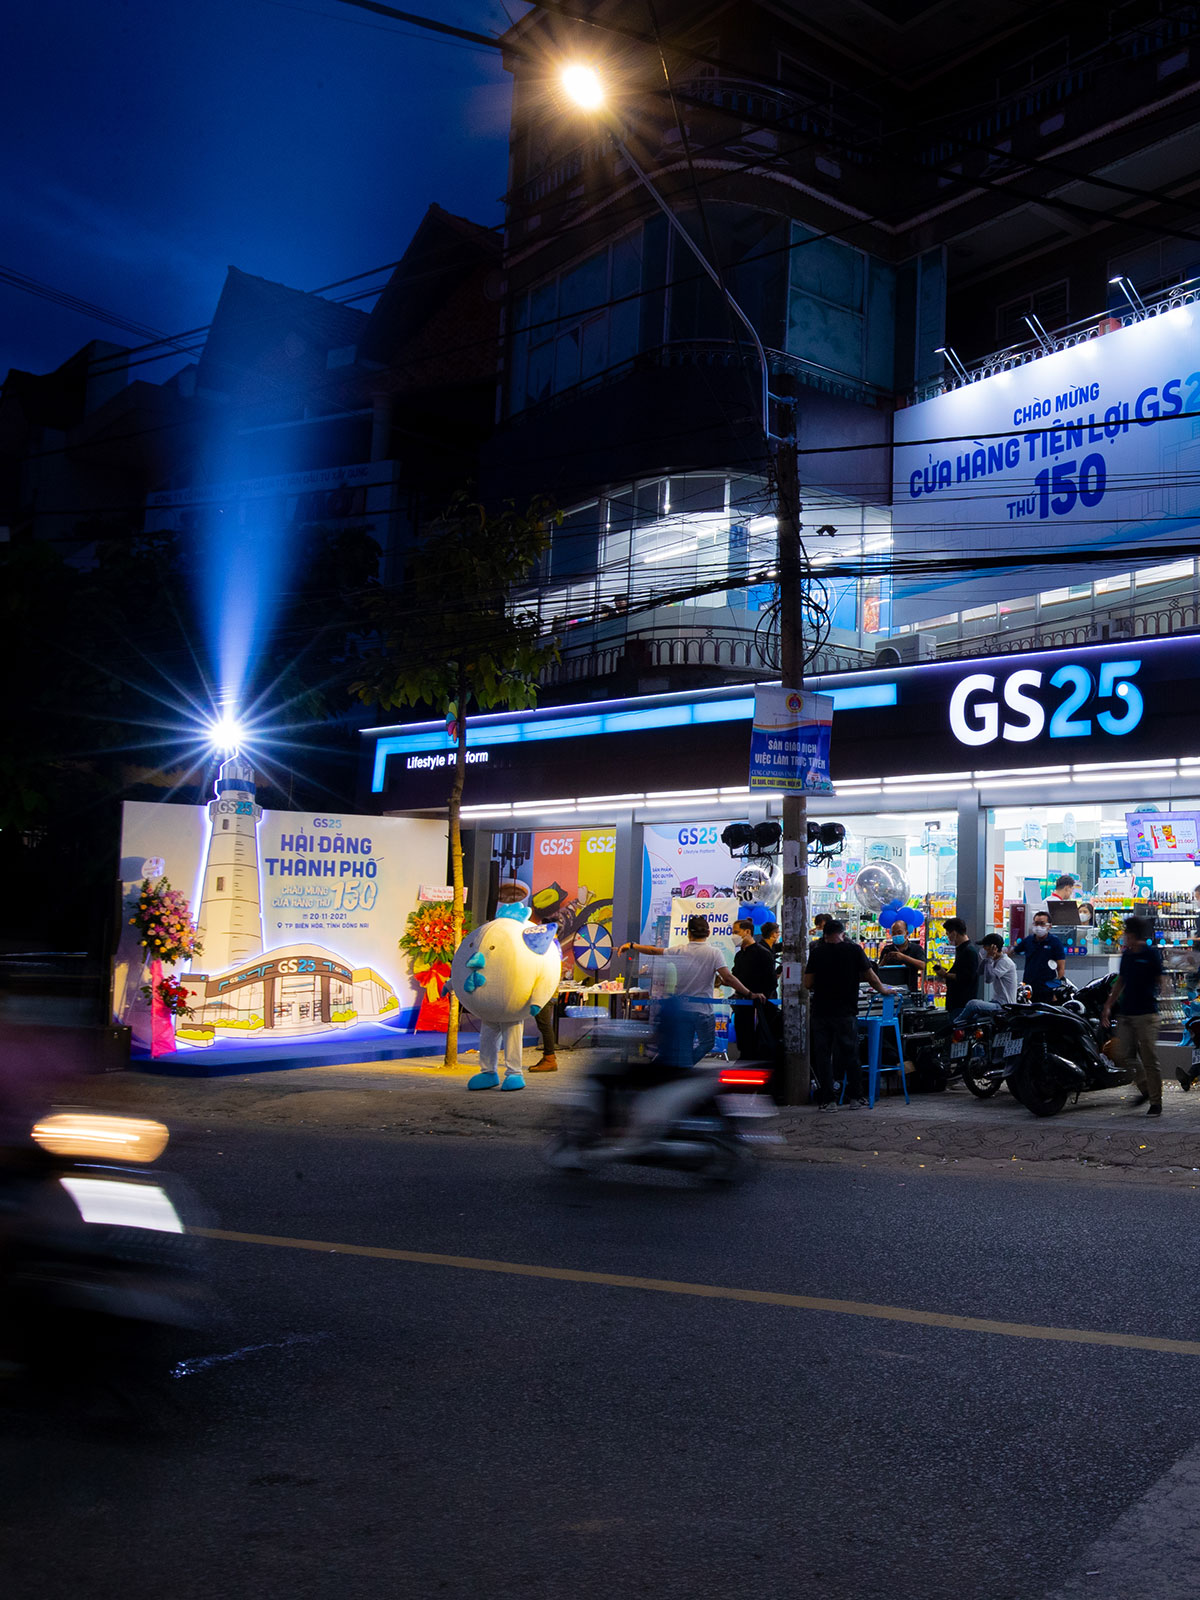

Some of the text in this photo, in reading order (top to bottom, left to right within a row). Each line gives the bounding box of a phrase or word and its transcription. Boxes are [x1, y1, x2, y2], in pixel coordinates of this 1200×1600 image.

[1013, 382, 1100, 426] CHÀO MỪNG
[909, 452, 952, 498] CỬA
[956, 439, 1020, 484] HÀNG
[1023, 418, 1084, 462] TIỆN
[1087, 401, 1129, 445] LỢI
[1006, 452, 1107, 520] THỨ 150
[948, 659, 1145, 747] GS25
[768, 738, 783, 751] SÀN
[784, 741, 800, 752] GIAO
[406, 750, 489, 770] Lifestyle Plform
[754, 752, 772, 766] VIỆC
[773, 753, 789, 766] LÀM
[217, 800, 253, 816] GS25
[313, 817, 342, 829] GS25
[281, 826, 372, 855] HẢI ĐĂNG
[678, 826, 718, 846] GS25
[540, 838, 573, 856] GS25
[264, 852, 385, 878] THÀNH PHỐ
[330, 880, 378, 911] 150
[278, 959, 317, 974] GS25
